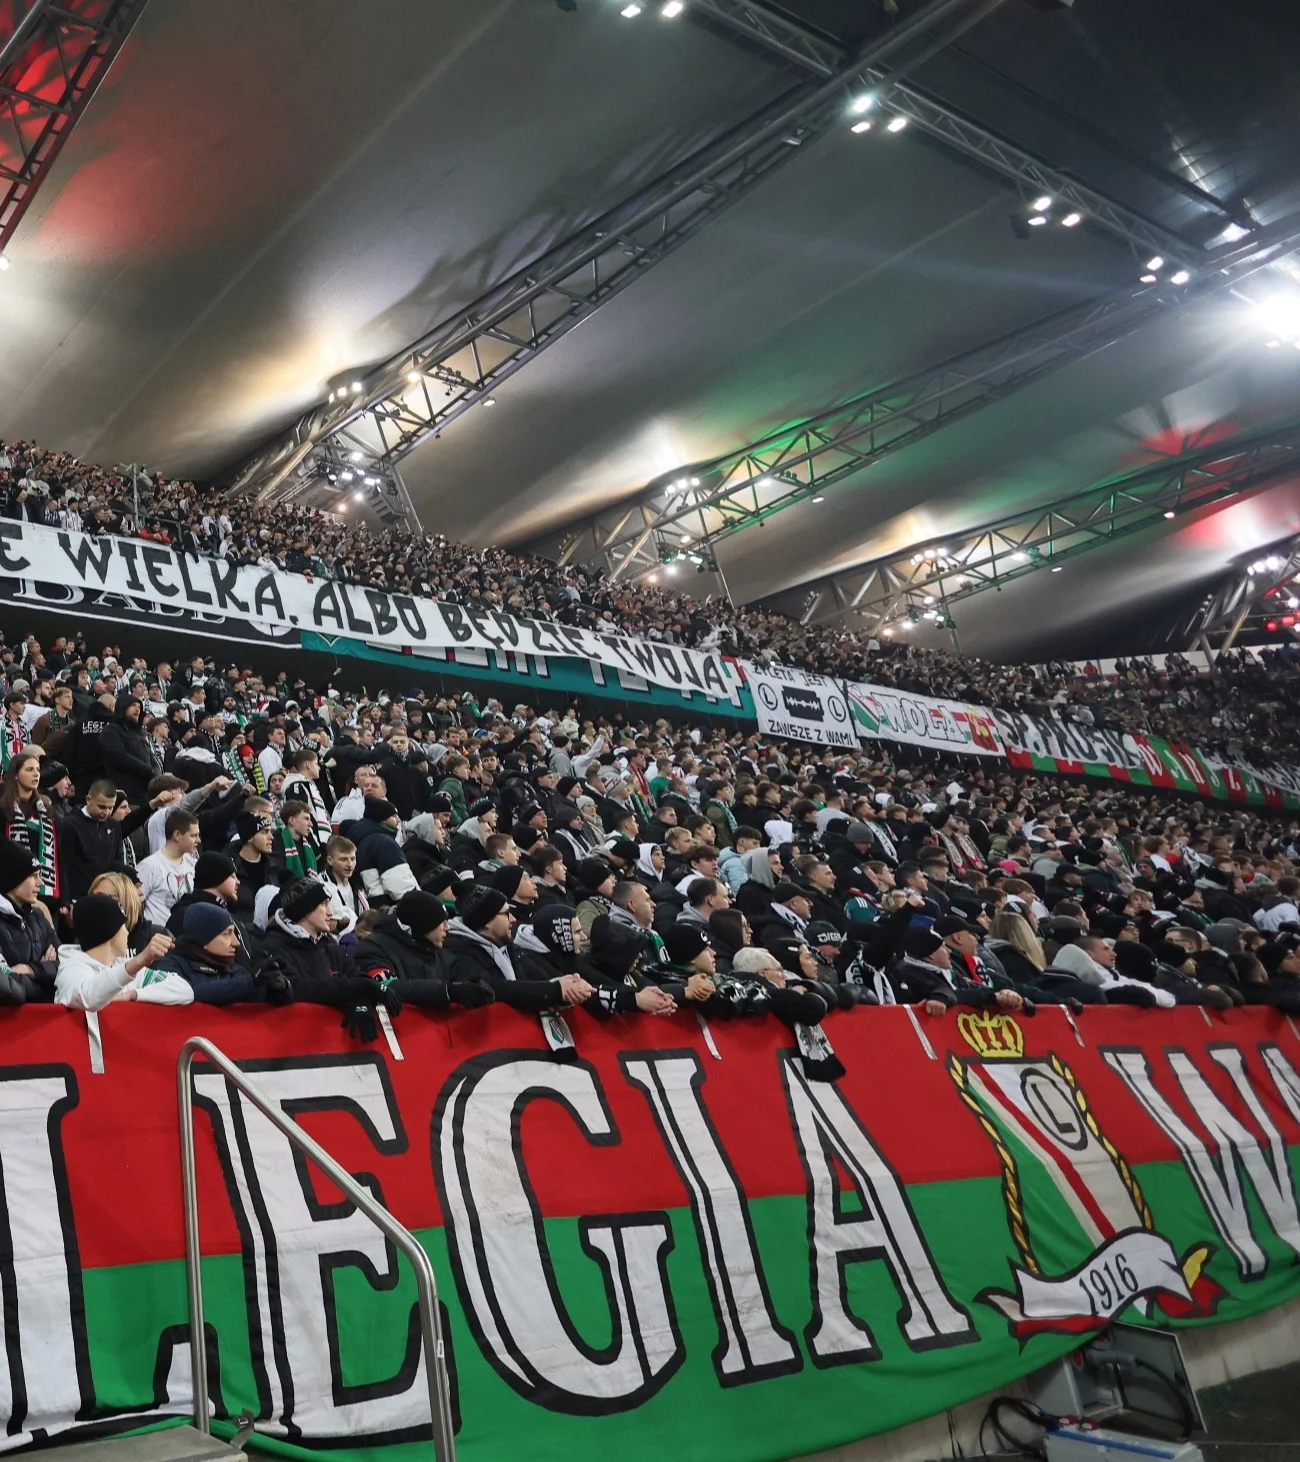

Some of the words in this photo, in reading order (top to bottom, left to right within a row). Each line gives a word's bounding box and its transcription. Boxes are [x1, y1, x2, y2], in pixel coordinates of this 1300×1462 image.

[313, 580, 427, 641] ALBO
[603, 637, 728, 696] TWOJA
[800, 672, 827, 687] JEST
[768, 719, 813, 740] ZAWSZE
[814, 728, 823, 742] Z
[825, 730, 854, 746] WAMI
[1079, 1253, 1139, 1317] 1916
